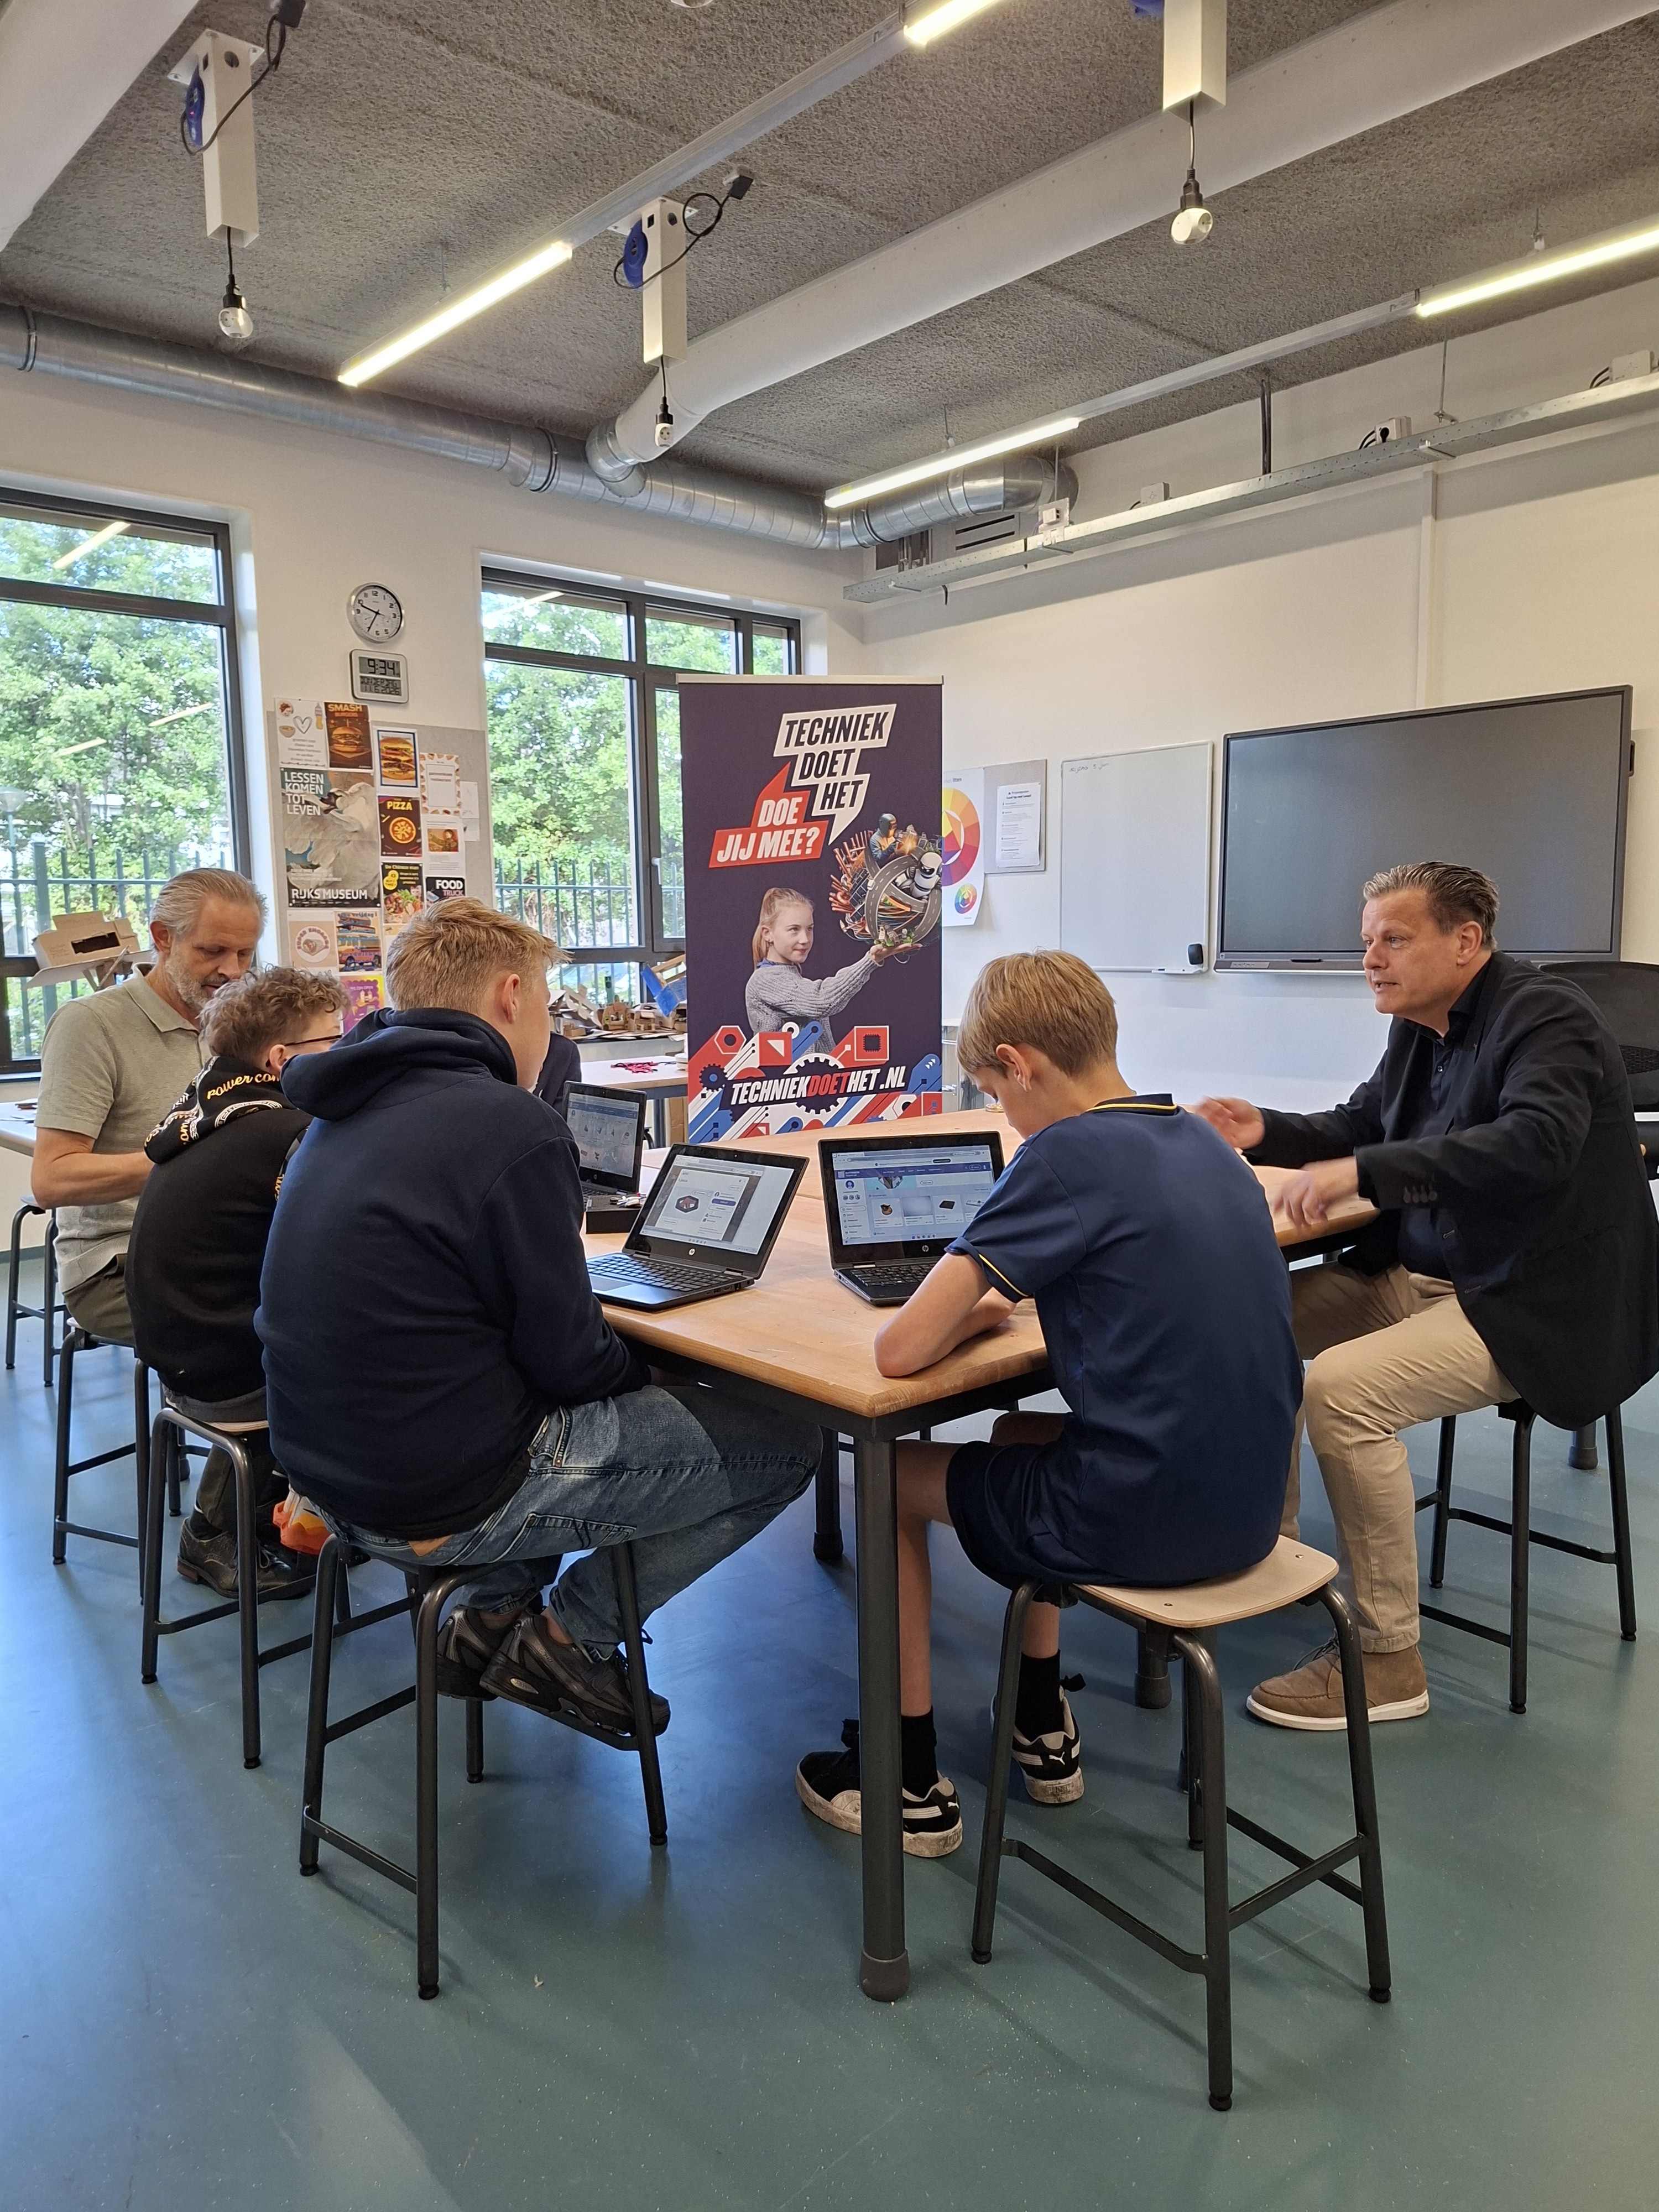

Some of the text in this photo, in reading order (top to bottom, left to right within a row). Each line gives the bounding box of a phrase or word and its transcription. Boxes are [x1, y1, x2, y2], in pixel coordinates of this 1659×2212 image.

[367, 659, 395, 676] 9:34
[328, 703, 363, 712] SMASH
[784, 711, 889, 748] TECHNIEK
[799, 748, 856, 780] DOET
[284, 771, 324, 784] LESSEN
[285, 782, 324, 795] KOMEN
[820, 779, 864, 811] HET
[285, 793, 307, 805] TOT
[286, 804, 321, 816] LEVEN
[387, 801, 413, 811] PIZZA
[757, 796, 803, 828] DOE
[716, 826, 820, 863] JIJ MEE?
[436, 880, 463, 890] FOOD
[291, 888, 368, 900] RIJKS MUSEUM
